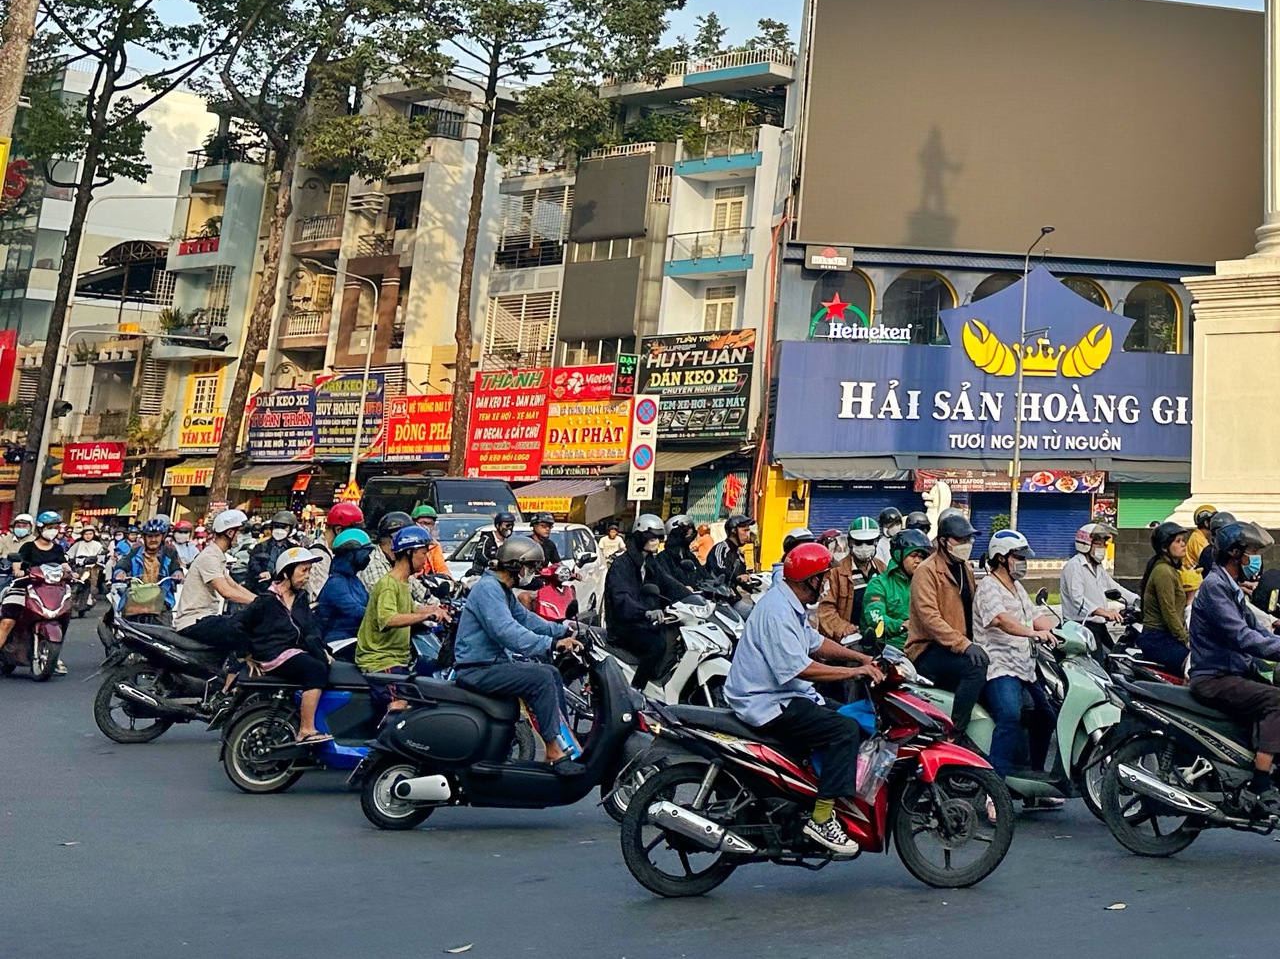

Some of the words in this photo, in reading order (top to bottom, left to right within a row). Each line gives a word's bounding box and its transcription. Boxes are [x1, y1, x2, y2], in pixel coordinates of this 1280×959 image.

[829, 323, 911, 340] Heineken
[619, 356, 637, 367] ĐẠI
[650, 368, 682, 387] DÁN
[684, 370, 715, 386] KEO
[717, 368, 739, 384] XE
[662, 386, 693, 395] CHUYÊN
[276, 396, 295, 407] KEO
[296, 395, 310, 406] XE
[501, 395, 512, 408] XE
[660, 400, 676, 410] TEM
[677, 399, 689, 410] XE
[712, 398, 725, 408] XE
[725, 395, 747, 408] MÁY
[838, 379, 921, 420] HẢI
[932, 381, 1003, 423] SẢN
[1014, 383, 1140, 425] HOÀNG
[1151, 395, 1193, 425] GI
[428, 417, 453, 441] PHÁ
[483, 427, 504, 440] DECAL
[548, 428, 579, 450] ĐẠI
[581, 421, 626, 445] PHÁT
[200, 431, 212, 443] XE
[264, 439, 272, 448] XE
[288, 439, 297, 447] XE
[949, 433, 985, 449] TƯƠI
[1043, 429, 1062, 450] TỪ
[1065, 429, 1122, 451] NGUỒN
[70, 444, 109, 462] THUẬN
